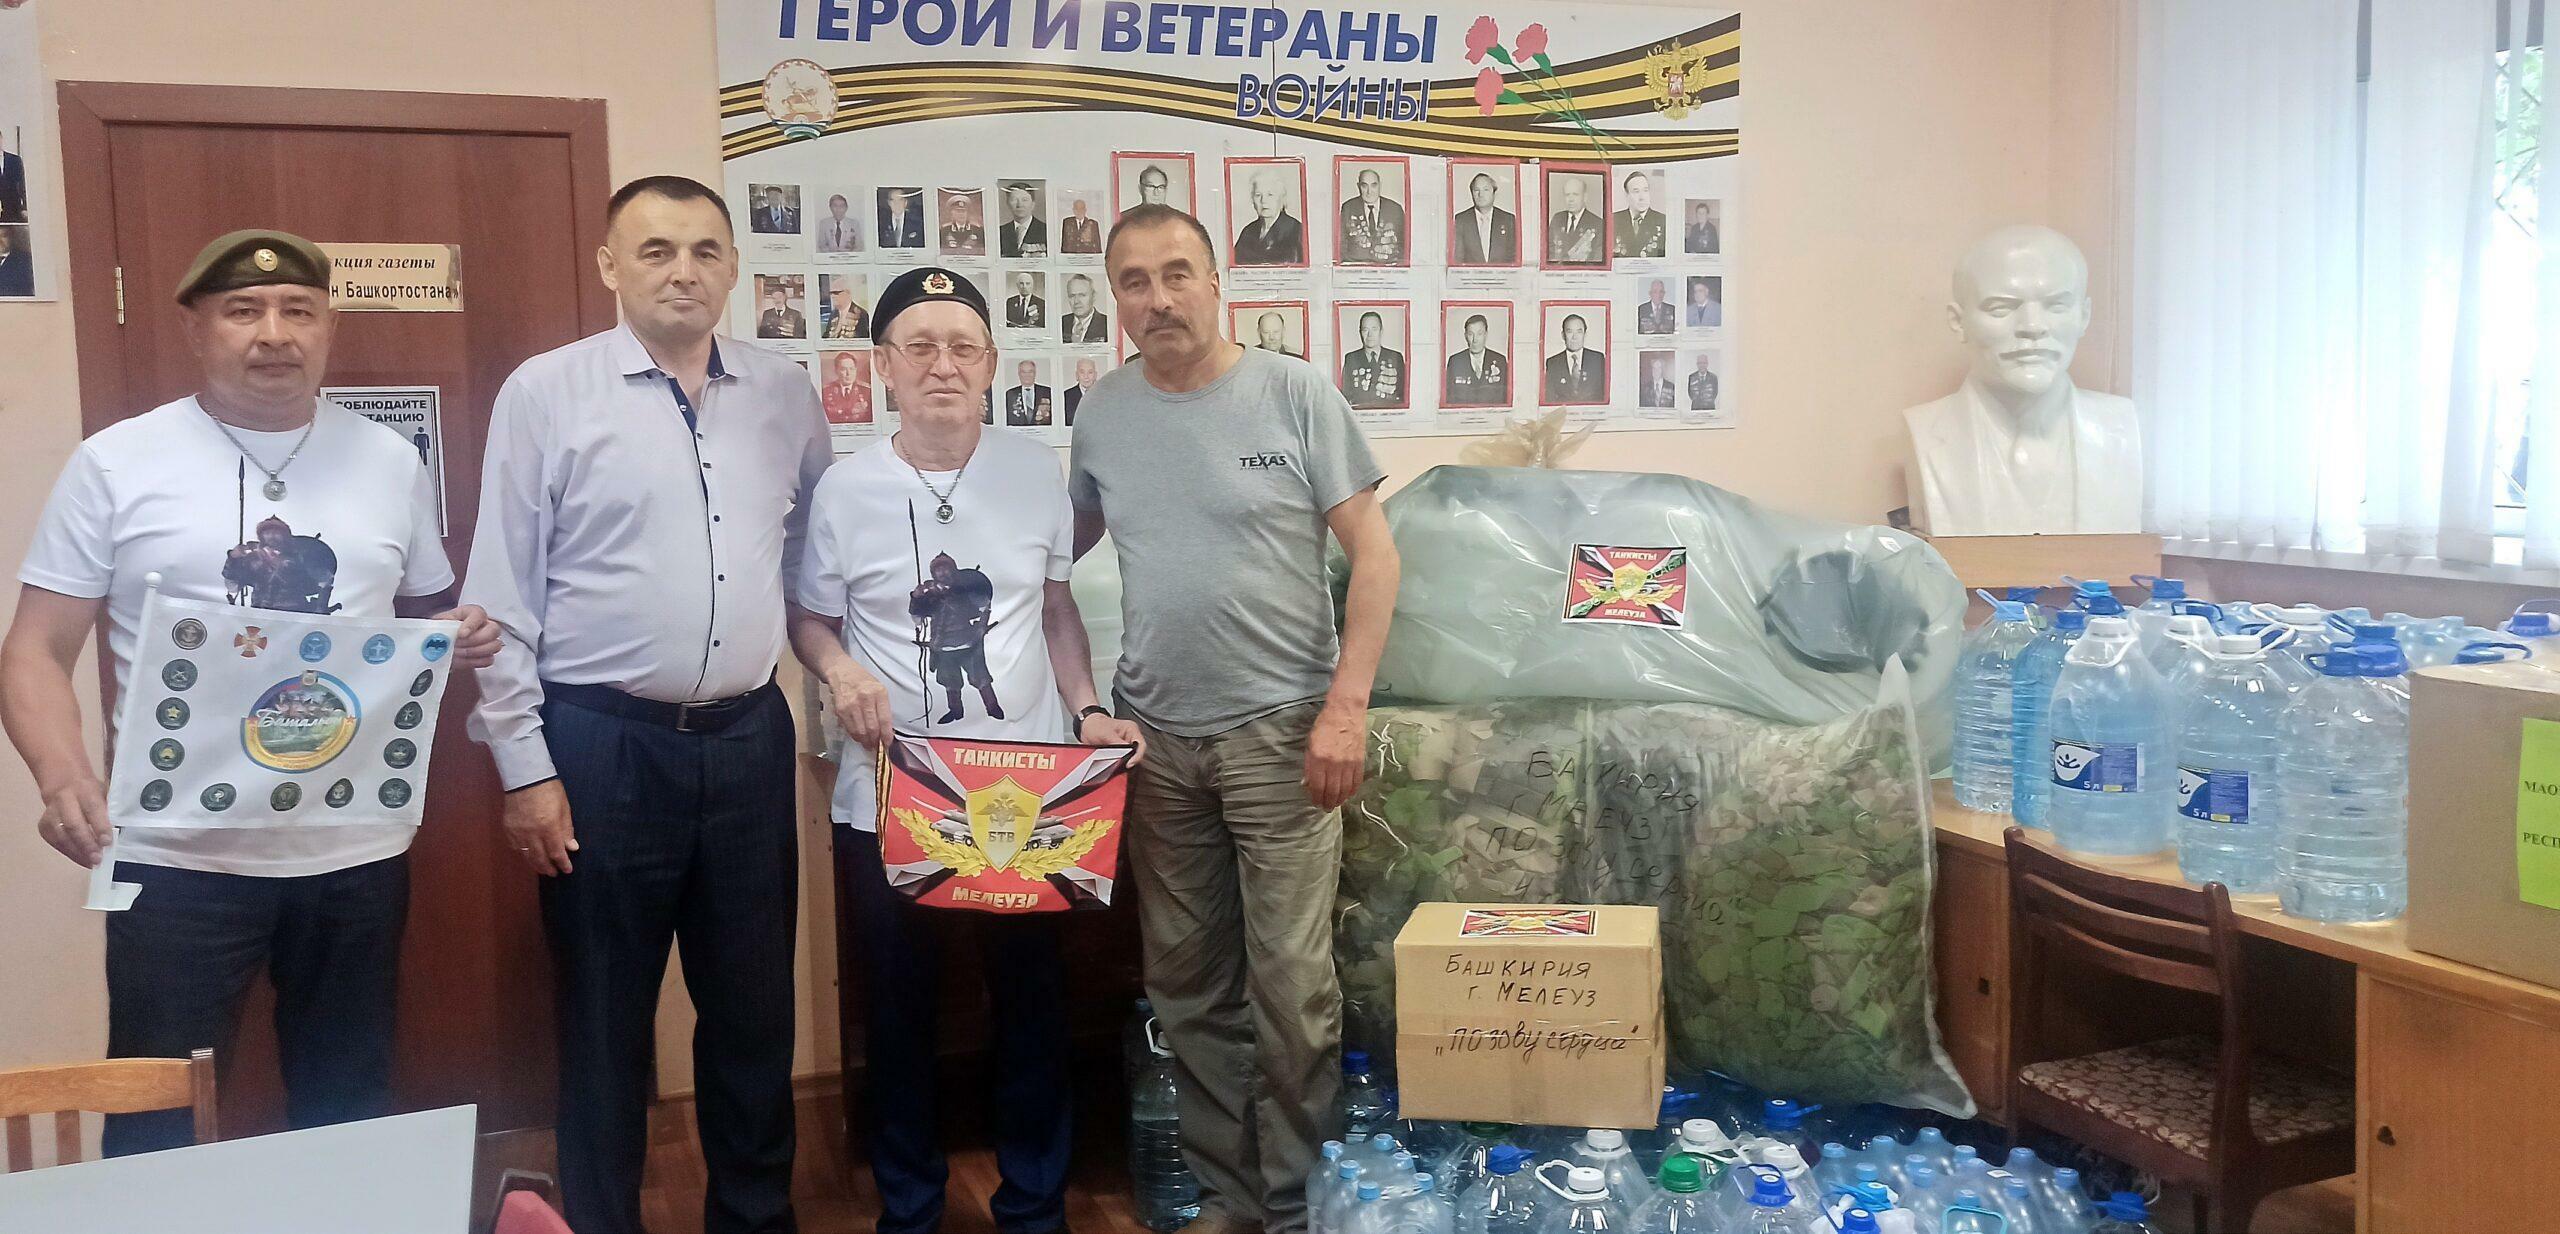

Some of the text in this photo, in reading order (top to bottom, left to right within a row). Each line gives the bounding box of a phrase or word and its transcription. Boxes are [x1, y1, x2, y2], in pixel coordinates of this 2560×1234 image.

[1022, 0, 1082, 51] И
[1100, 0, 1439, 64] ВЕТЕРАНЫ
[1234, 64, 1431, 122] ВОЙНЫ
[334, 257, 436, 271] кция газеты
[335, 399, 427, 411] ОБЛЮДАЙТЕ
[360, 413, 425, 424] ТАНЦИЮ
[1239, 451, 1287, 470] TEXAS
[1609, 551, 1657, 561] ТАНКИСТЫ
[1604, 608, 1647, 619] МЕЛЕУЗА
[953, 748, 1057, 770] ТАНКИСТЫ
[2083, 780, 2091, 789] 5
[2524, 780, 2560, 796] МАО
[1537, 790, 1652, 840] МЕЕУЗ
[2192, 807, 2200, 817] 5
[988, 831, 1015, 844] БТВ
[1445, 953, 1592, 979] БАШКИРИЯ
[1496, 981, 1599, 1008] МЕЛЕУЗ
